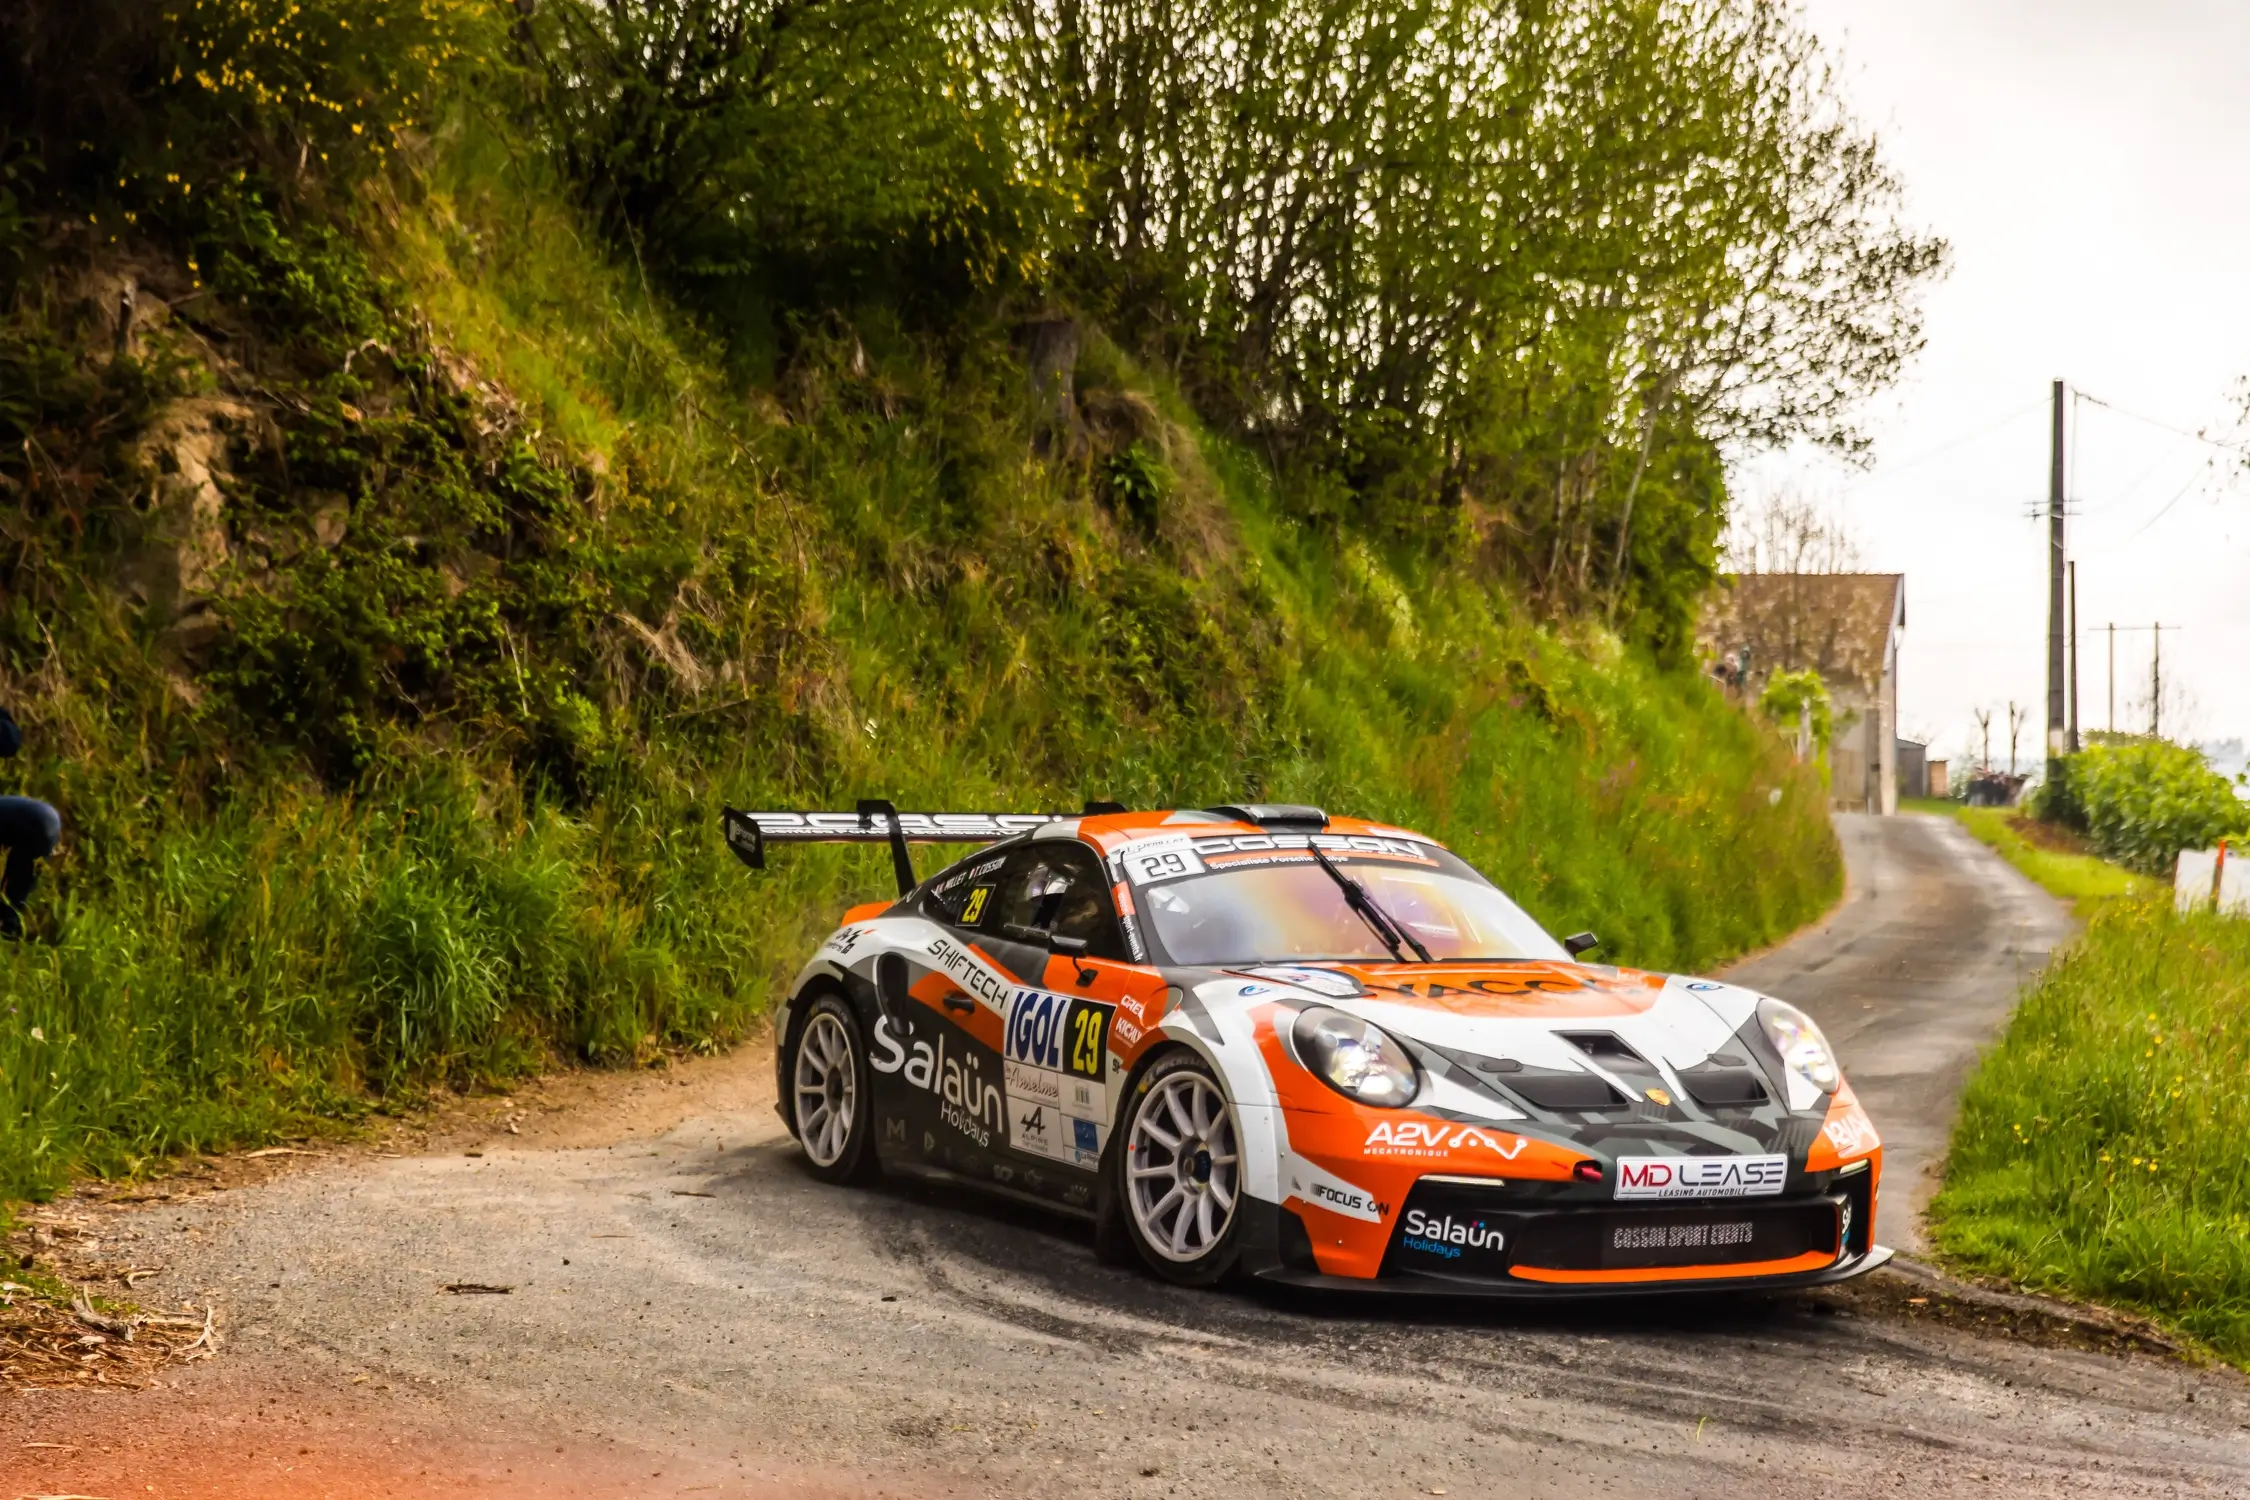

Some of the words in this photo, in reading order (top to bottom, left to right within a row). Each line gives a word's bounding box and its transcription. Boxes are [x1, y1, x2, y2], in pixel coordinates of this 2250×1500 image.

[1193, 834, 1428, 859] COSSON
[1270, 855, 1314, 864] Porsche
[1140, 853, 1187, 877] 29
[961, 889, 988, 922] 29
[927, 939, 1008, 1010] SHIFTECH
[1005, 991, 1068, 1068] IGOL
[1072, 1008, 1104, 1076] 29
[868, 1014, 1003, 1133] Salaün
[1021, 1132, 1049, 1146] ALPINE
[1365, 1121, 1450, 1146] A2V
[1622, 1164, 1672, 1188] MD
[1678, 1162, 1784, 1186] LEASE
[1317, 1185, 1362, 1209] FOCUS
[1367, 1200, 1390, 1216] ON
[1658, 1188, 1694, 1197] LEASING
[1696, 1187, 1748, 1197] AUTOMOBILE
[1404, 1210, 1504, 1251] Salaün
[1614, 1227, 1667, 1249] COSSON
[1668, 1225, 1709, 1247] SPORT
[1710, 1222, 1753, 1245] EVENTS
[1403, 1236, 1461, 1258] Holidays
